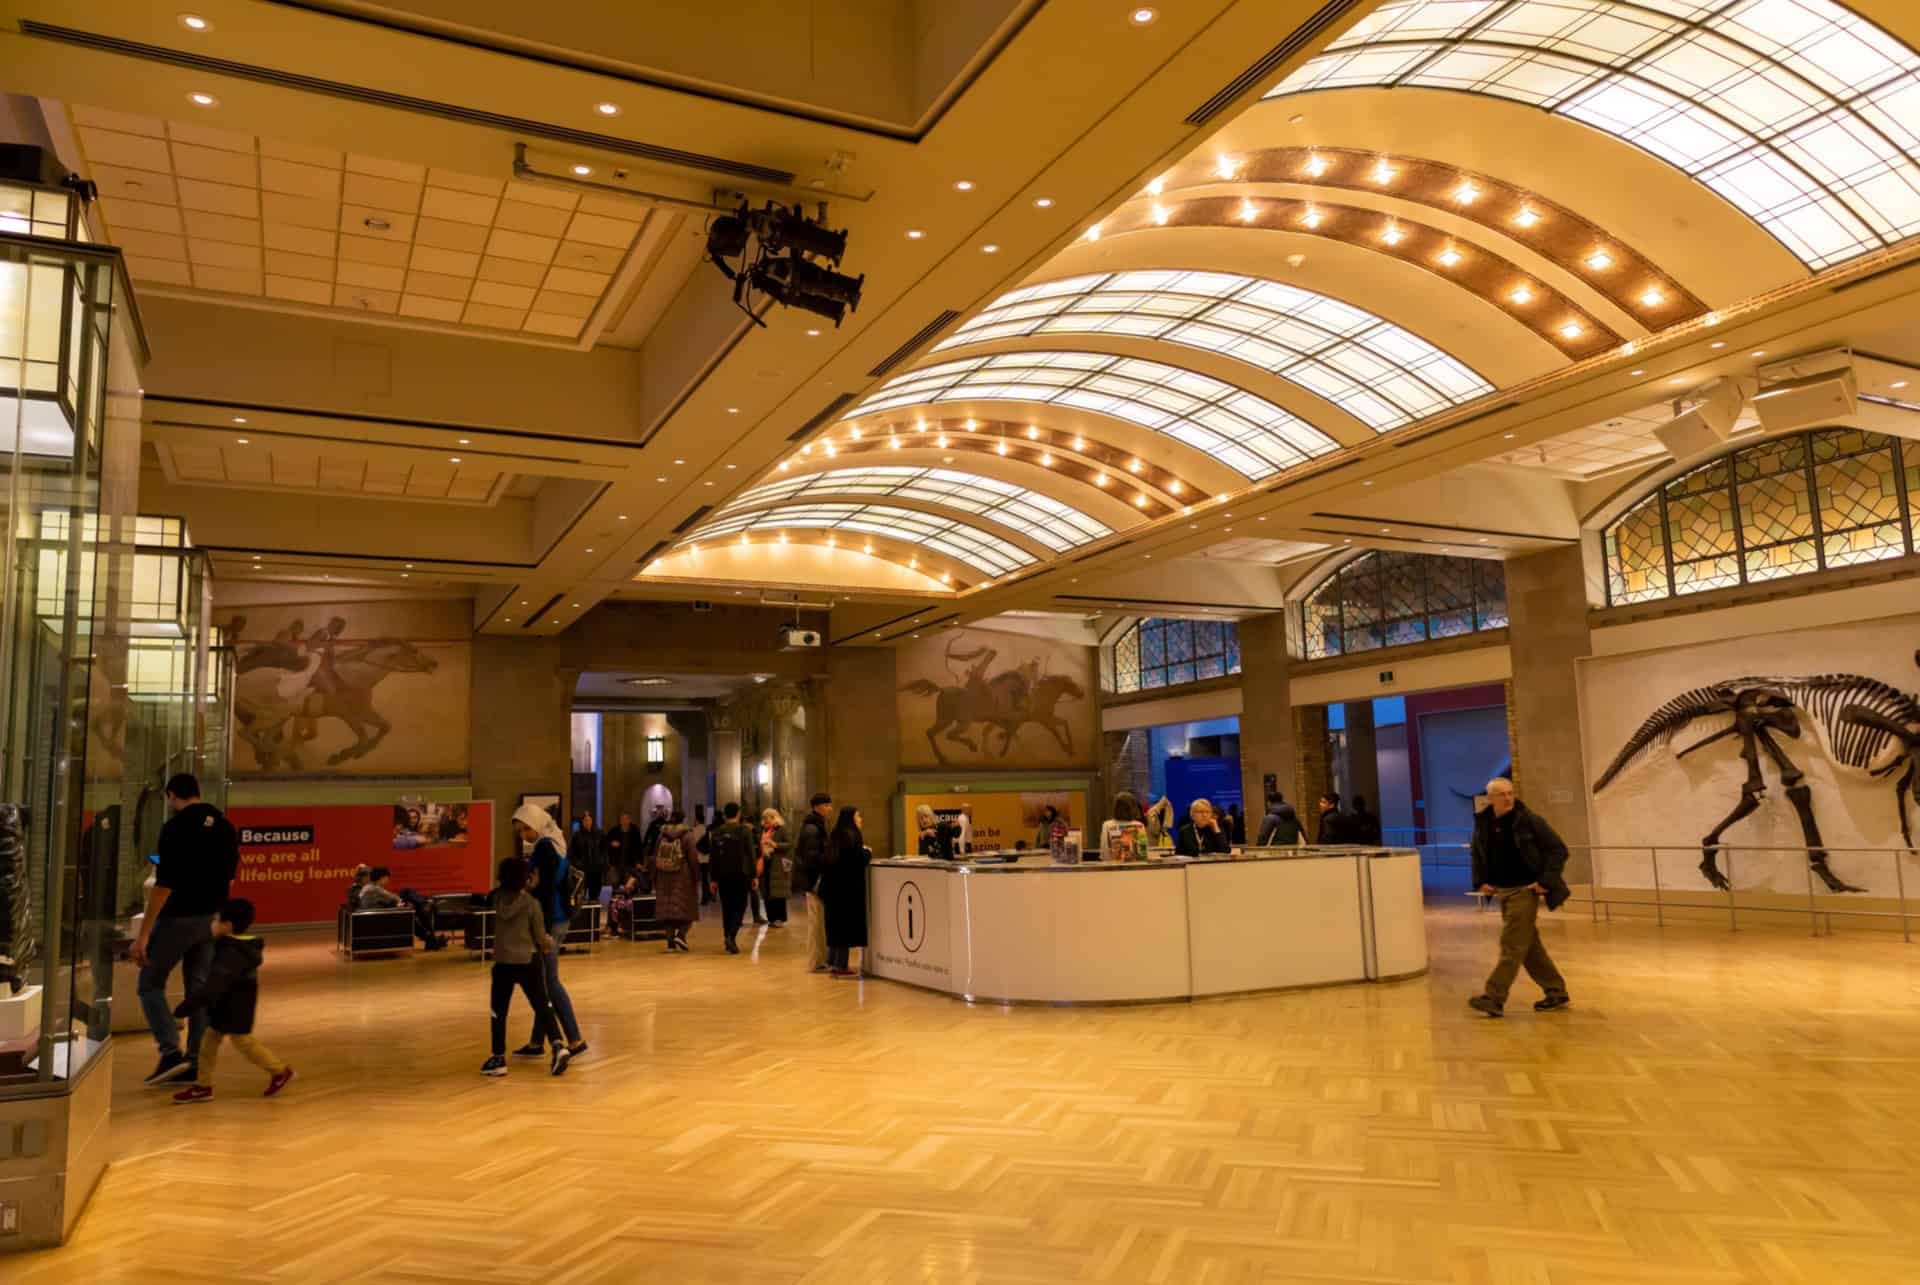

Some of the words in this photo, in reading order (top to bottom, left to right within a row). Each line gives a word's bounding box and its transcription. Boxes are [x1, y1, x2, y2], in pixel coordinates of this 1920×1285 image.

[241, 829, 310, 843] Because
[240, 852, 266, 865] we
[270, 851, 297, 863] are
[301, 847, 320, 861] all
[240, 867, 304, 884] lifelong
